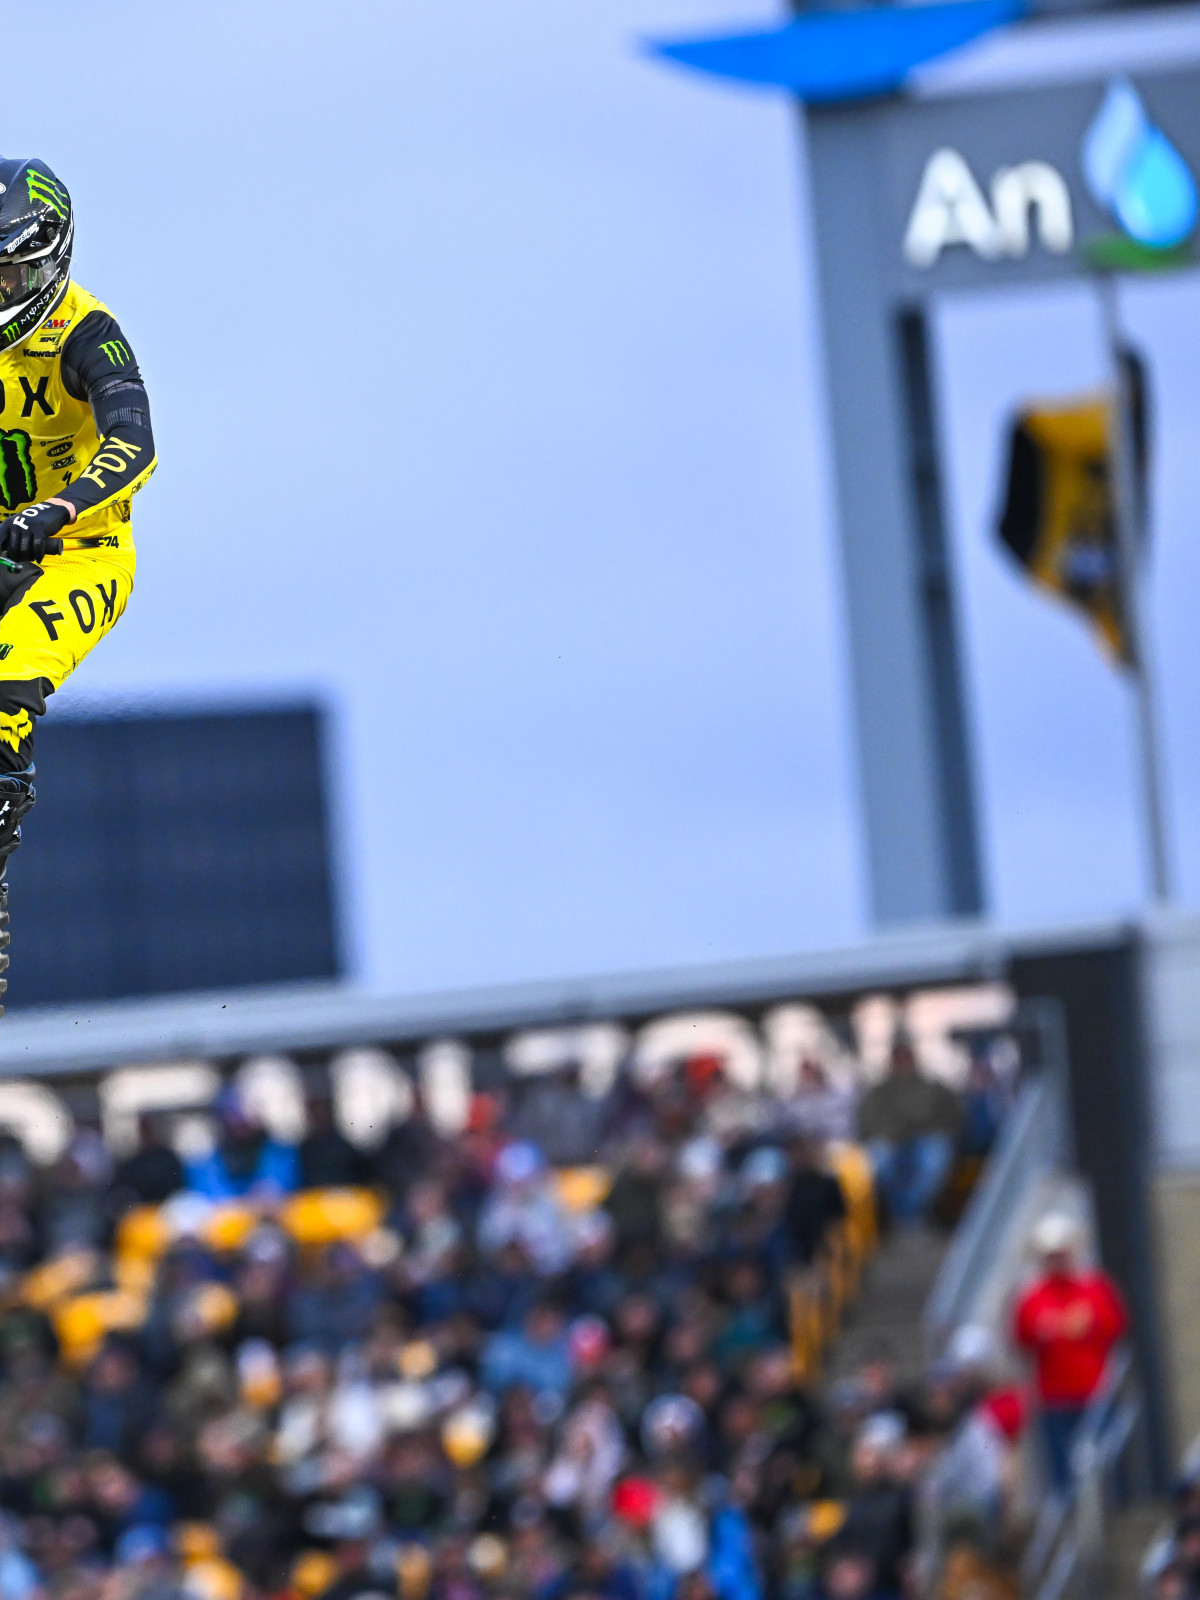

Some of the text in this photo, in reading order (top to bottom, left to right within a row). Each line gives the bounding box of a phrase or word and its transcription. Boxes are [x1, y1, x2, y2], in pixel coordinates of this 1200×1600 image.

[906, 147, 1073, 268] An
[81, 437, 142, 489] FOX
[13, 503, 51, 530] FOX
[29, 579, 117, 641] FOX
